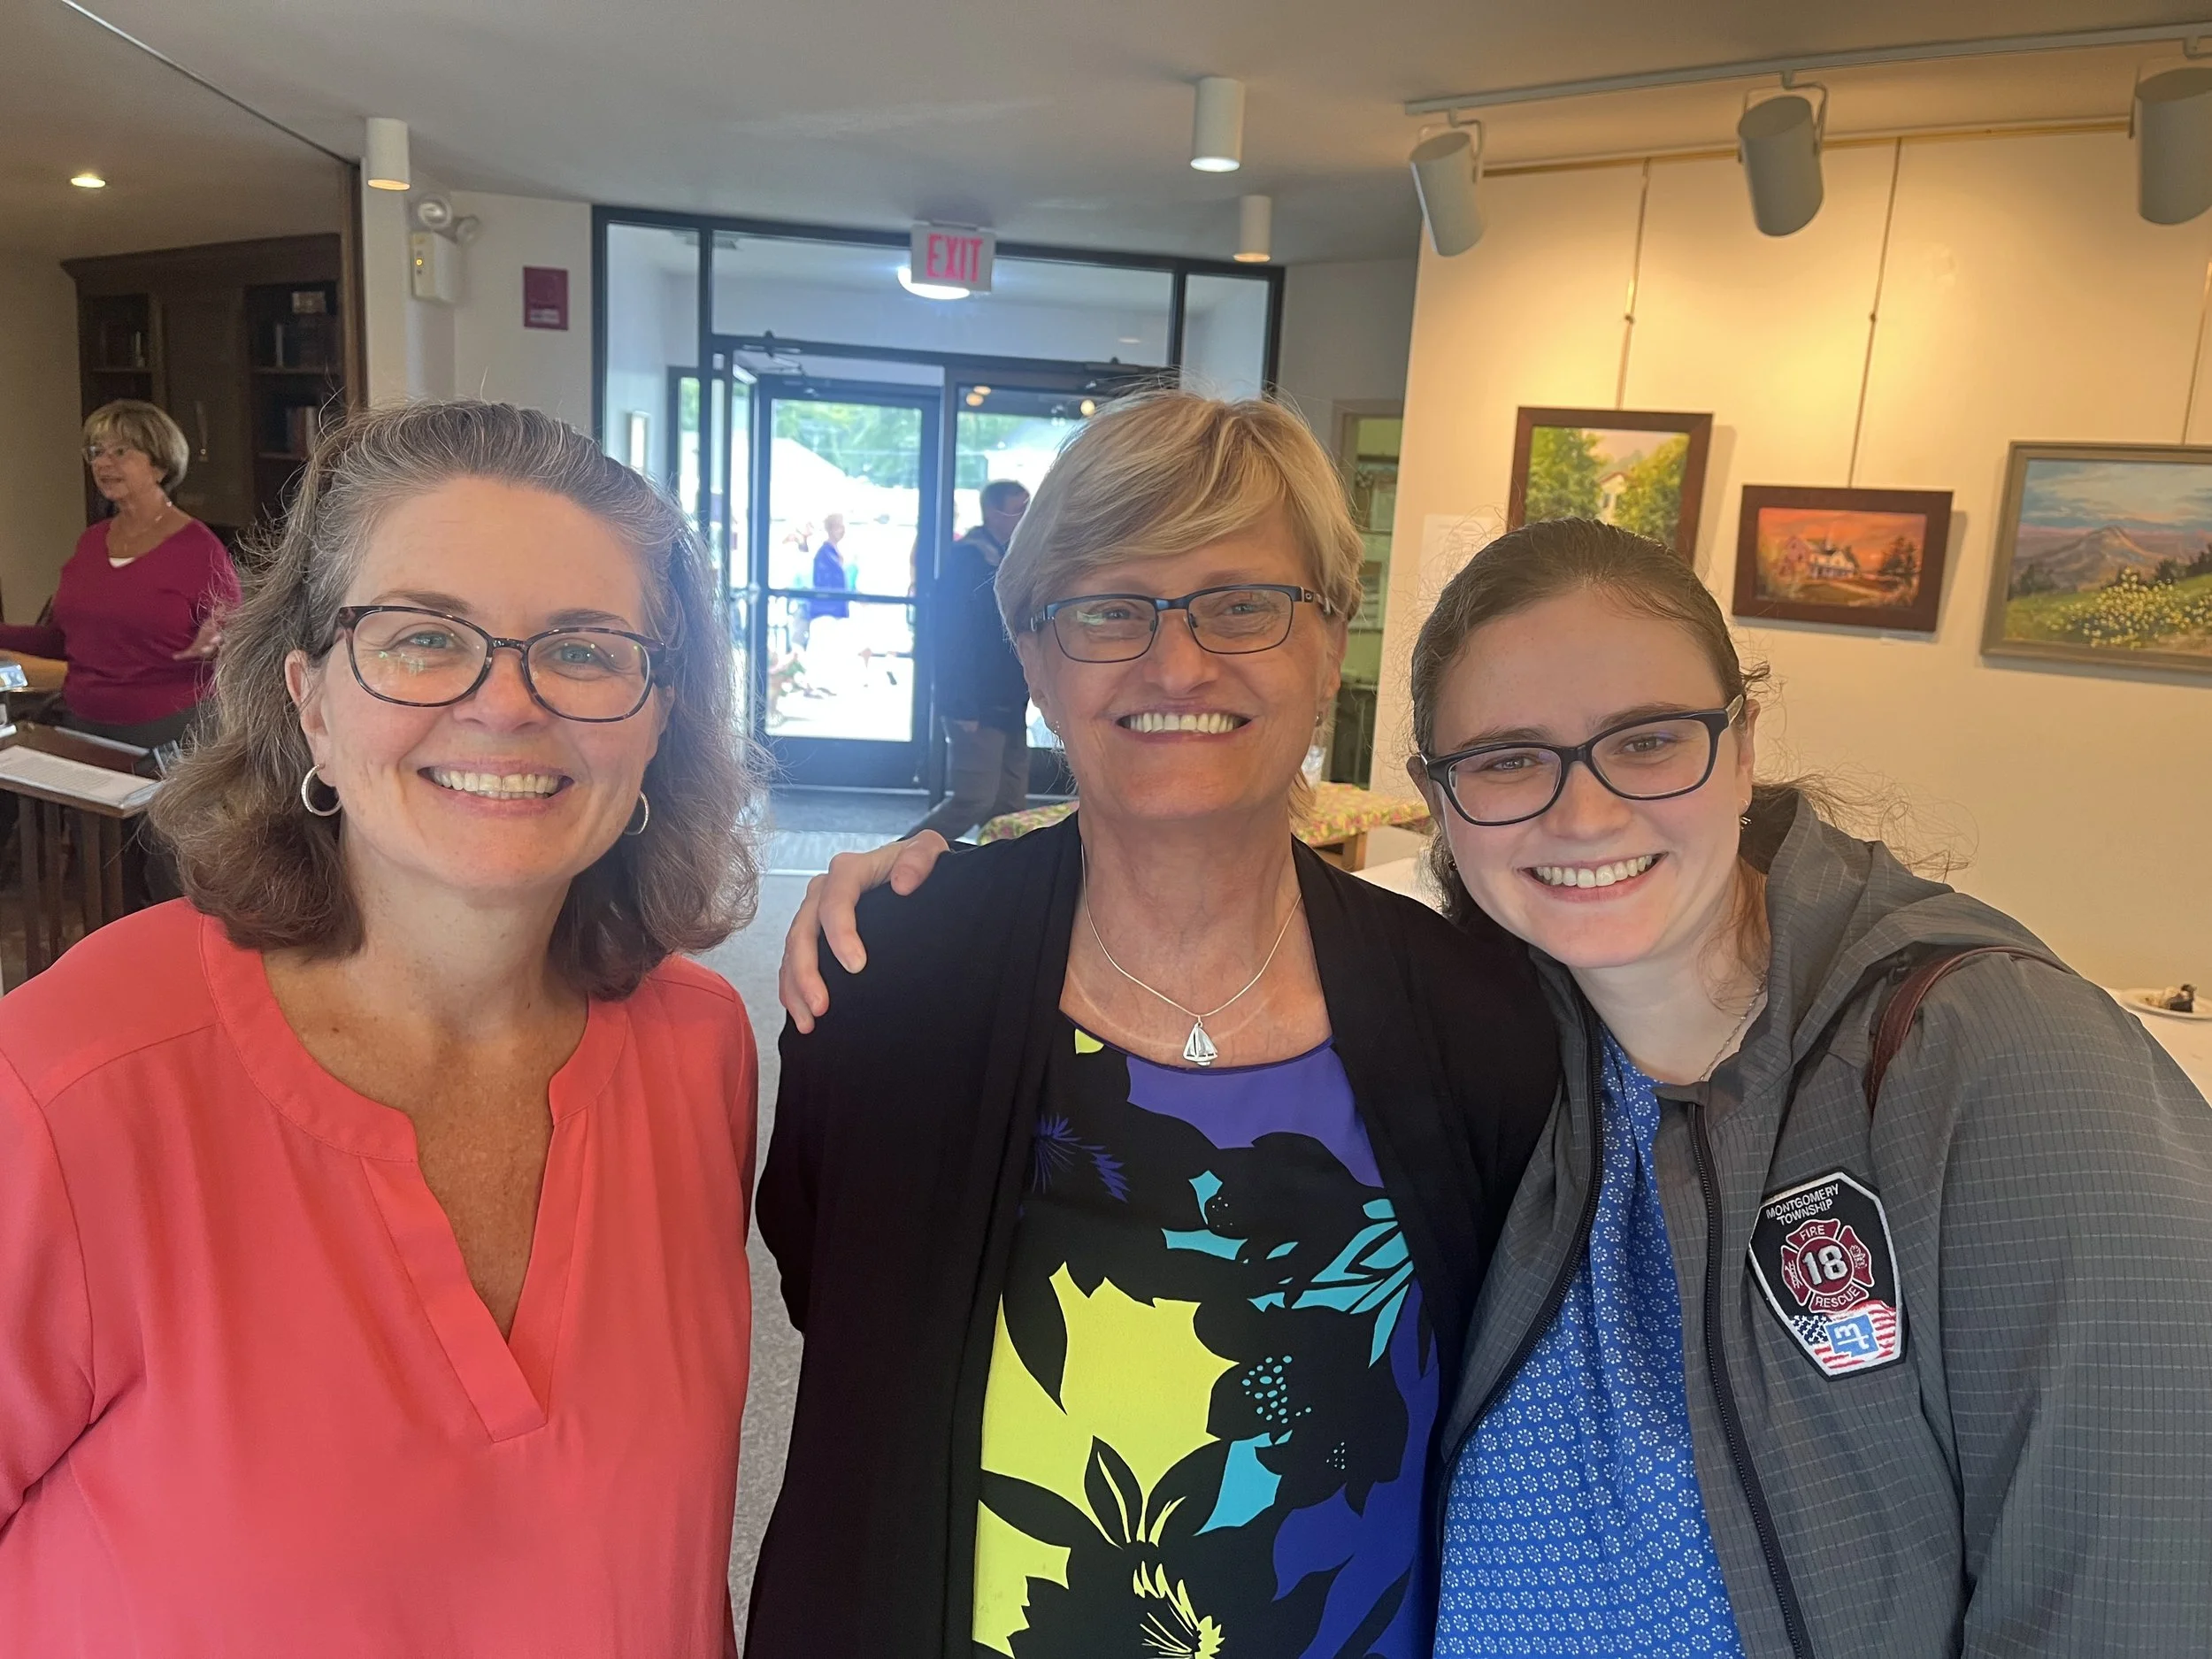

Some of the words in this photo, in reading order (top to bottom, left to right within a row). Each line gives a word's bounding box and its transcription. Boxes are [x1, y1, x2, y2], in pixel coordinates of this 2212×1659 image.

[926, 233, 984, 282] EXIT
[1765, 1183, 1839, 1219] MONTGOMERY
[1776, 1198, 1833, 1226] TOWNSHIP
[1799, 1225, 1825, 1241] FIRE
[1802, 1244, 1848, 1286] 18
[1816, 1286, 1861, 1308] RESCUE
